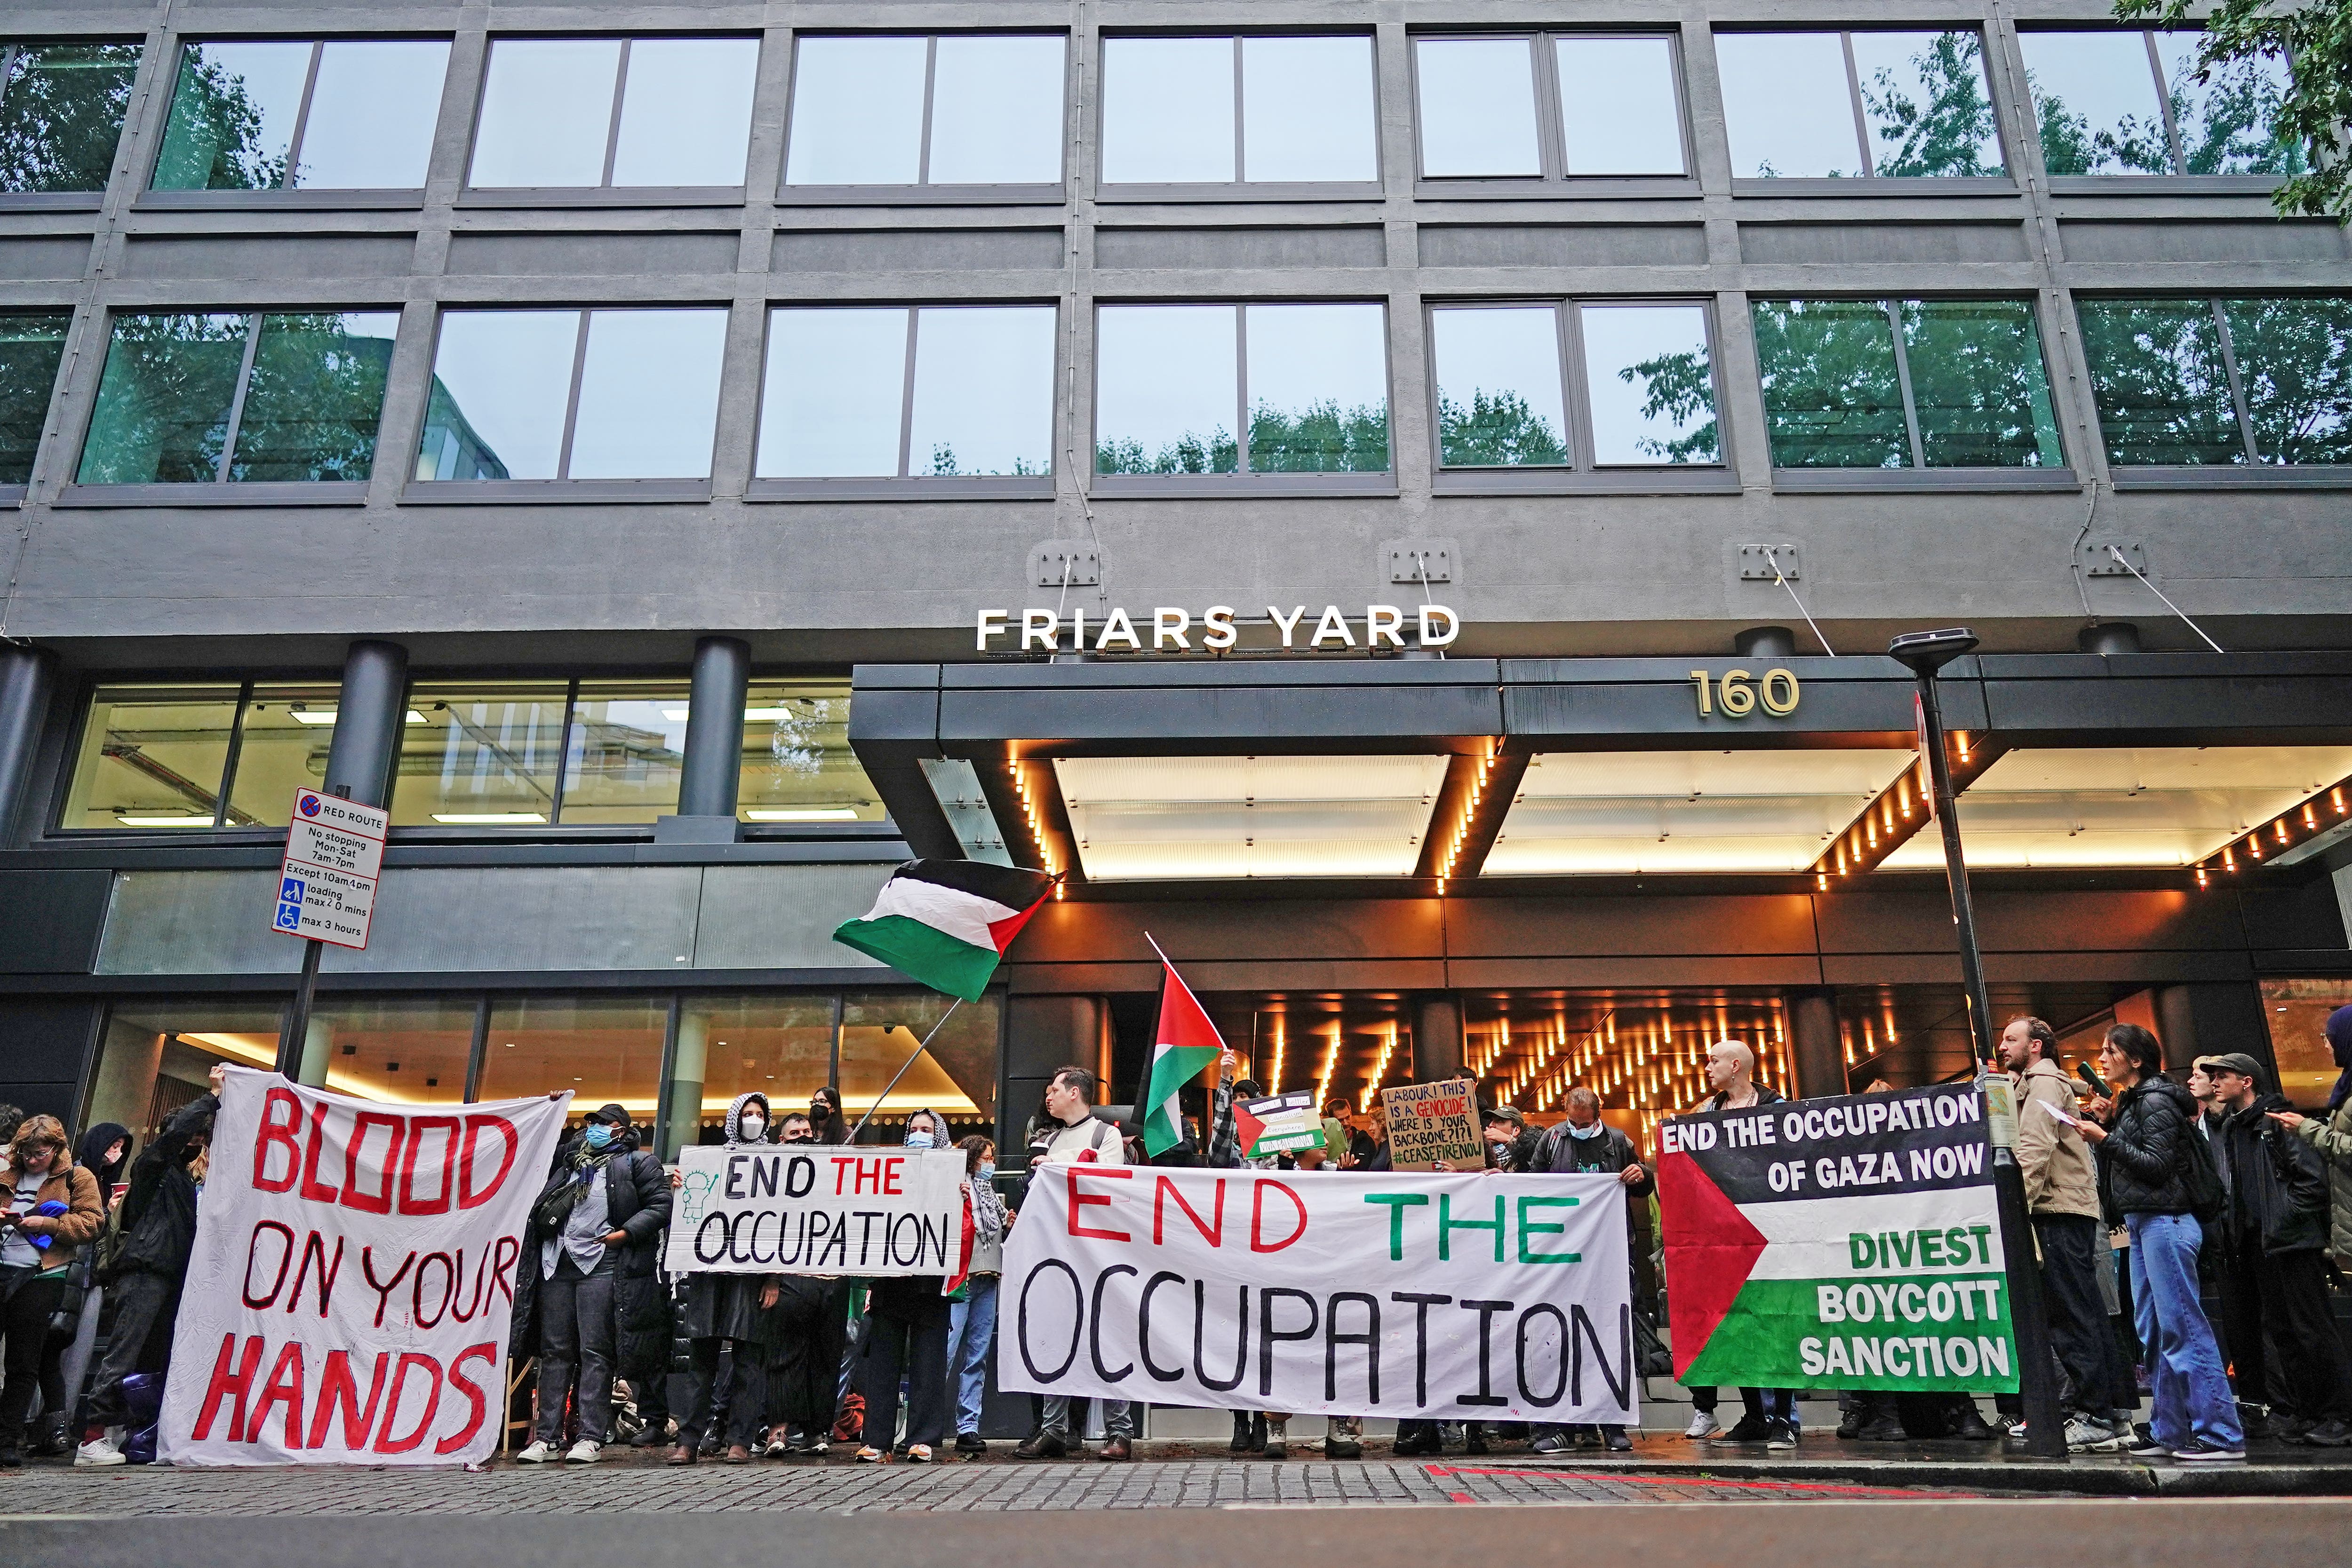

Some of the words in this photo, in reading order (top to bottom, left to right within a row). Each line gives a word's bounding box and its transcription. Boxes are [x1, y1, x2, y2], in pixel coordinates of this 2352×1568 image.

[976, 605, 1239, 653] FRIARS
[1267, 605, 1460, 650] YARD
[1690, 668, 1801, 715] 160
[324, 805, 344, 818] RED
[349, 812, 383, 829] ROUTE
[308, 827, 322, 838] No
[325, 833, 367, 850] stopping
[315, 840, 356, 858] Mon-Sat
[287, 863, 320, 879] Except
[312, 851, 355, 869] 7am-7pm
[307, 883, 343, 901] loading
[305, 896, 325, 907] max
[345, 906, 367, 917] mins
[302, 916, 321, 927] max
[325, 920, 332, 929] 3
[334, 923, 361, 936] hours
[1387, 1085, 1437, 1103] LABOUR!
[1440, 1081, 1466, 1097] THIS
[1250, 1103, 1271, 1113] Death
[1269, 1111, 1302, 1122] Colonialism
[1390, 1106, 1400, 1117] IS
[1405, 1105, 1414, 1116] A
[1268, 1124, 1304, 1133] Everywhere!
[1389, 1117, 1420, 1133] WHERE
[1423, 1118, 1433, 1130] IS
[1440, 1114, 1469, 1127] YOUR
[1661, 1122, 1718, 1154] END
[1724, 1114, 1776, 1149] THE
[1782, 1092, 1980, 1141] OCCUPATION
[1260, 1141, 1275, 1151] VIVA
[1394, 1126, 1472, 1147] BACKBONE?!?!
[252, 1087, 519, 1216] BLOOD
[1393, 1141, 1482, 1164] #CEASEFIRENOW
[725, 1155, 815, 1199] END
[830, 1157, 905, 1195] THE
[1767, 1160, 1806, 1193] OF
[1815, 1153, 1904, 1189] GAZA
[1910, 1142, 1984, 1182] NOW
[1067, 1167, 1308, 1254] END
[1364, 1193, 1582, 1264] THE
[694, 1210, 948, 1267] OCCUPATION
[1849, 1225, 1992, 1269] DIVEST
[242, 1219, 344, 1319] ON
[362, 1235, 519, 1329] YOUR
[1817, 1280, 2000, 1323] BOYCOTT
[1019, 1258, 1630, 1412] OCCUPATION
[1799, 1336, 2009, 1377] SANCTION
[191, 1332, 498, 1455] HANDS
